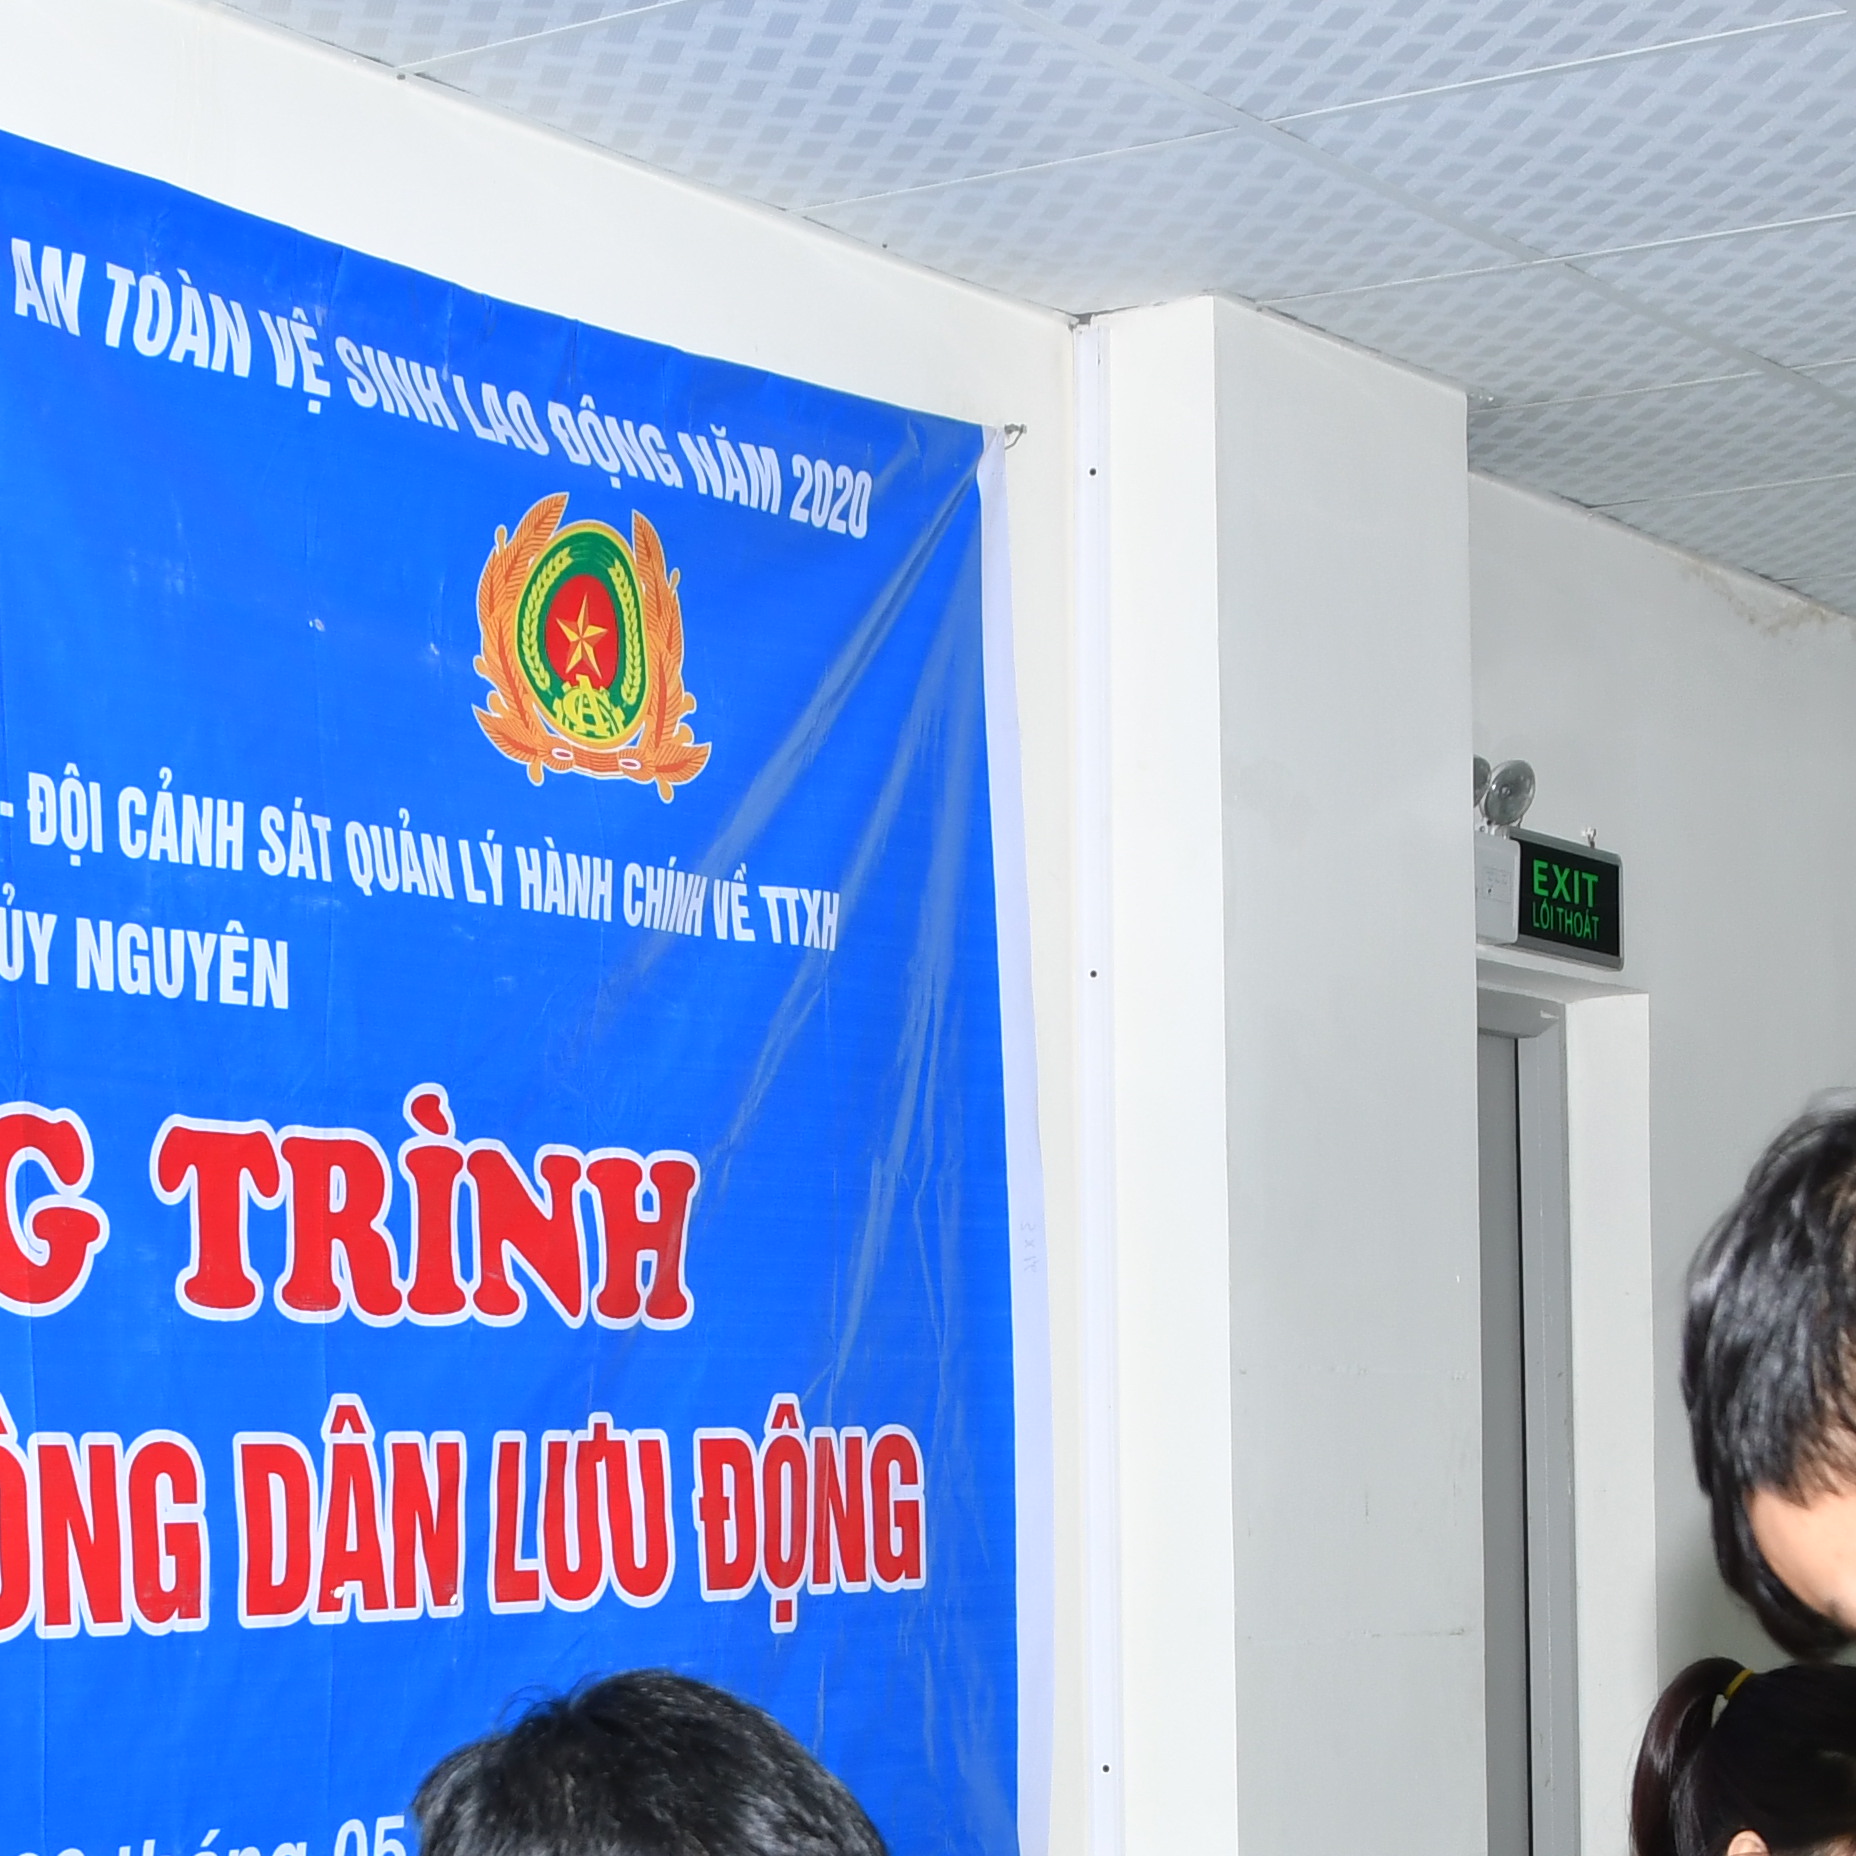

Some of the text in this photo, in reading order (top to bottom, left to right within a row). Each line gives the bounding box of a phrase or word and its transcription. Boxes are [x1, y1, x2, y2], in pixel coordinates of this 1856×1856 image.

[10, 236, 88, 338] AN
[104, 261, 253, 379] TOÀN
[257, 305, 332, 415] VỆ
[334, 335, 460, 433] SINH
[451, 373, 551, 457] LAO
[546, 393, 685, 490] ĐỘNG
[676, 422, 783, 516] NĂM
[788, 448, 874, 540] 2020
[25, 761, 105, 868] ĐỘI
[116, 765, 246, 872] CẢNH
[256, 795, 334, 884] SÁT
[343, 806, 456, 901] QUẢN
[457, 827, 505, 907] LÝ
[513, 855, 614, 924] HÀNH
[622, 861, 710, 938] CHÍNH
[711, 861, 757, 943] VỀ
[757, 884, 841, 953] TTXH
[1532, 858, 1600, 909] EXIT
[1556, 906, 1600, 942] THOÁT
[74, 916, 290, 1011] NGUYÊN
[150, 1086, 703, 1327] TRÌNH
[234, 1398, 467, 1623] DÂN
[487, 1415, 676, 1610] LƯU
[691, 1396, 928, 1630] ĐỘNG
